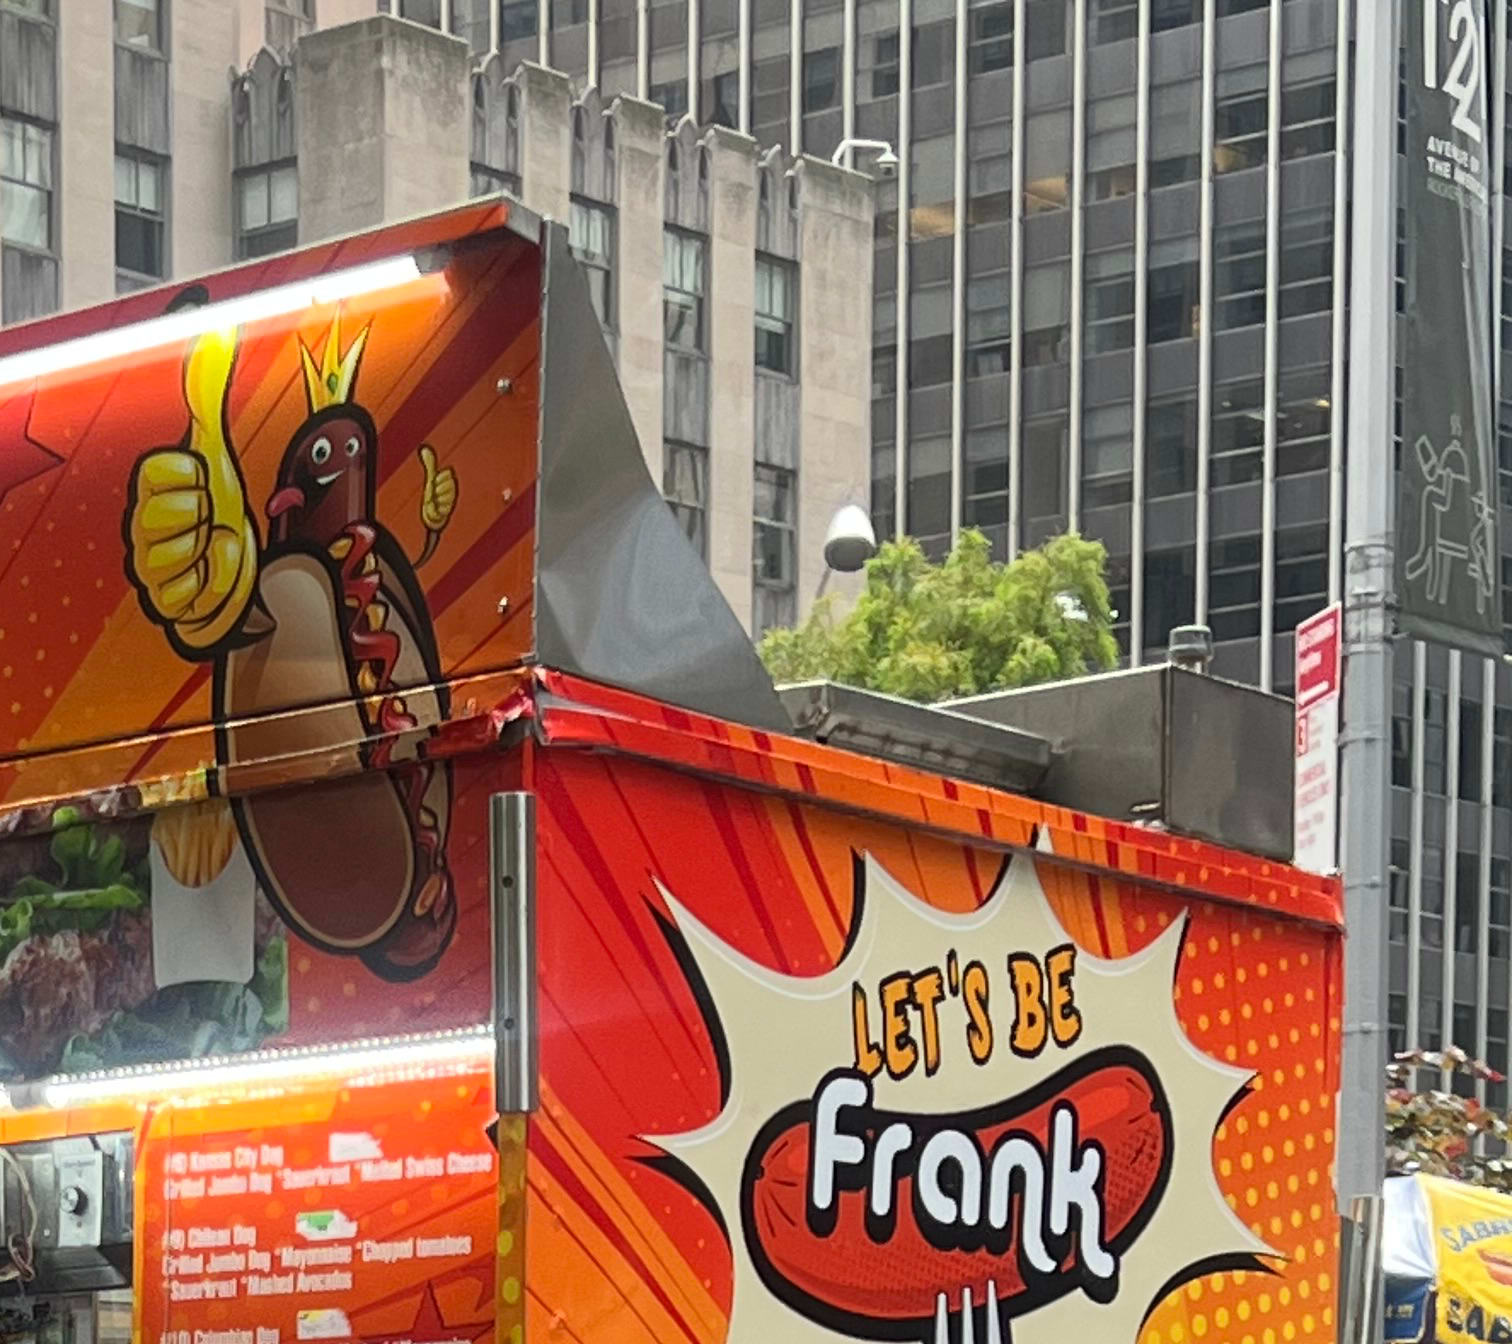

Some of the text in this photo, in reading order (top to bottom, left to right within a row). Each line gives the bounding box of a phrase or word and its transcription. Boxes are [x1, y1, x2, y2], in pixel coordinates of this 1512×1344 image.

[852, 944, 1082, 1079] LET'S BE
[814, 1076, 1114, 1278] Frank
